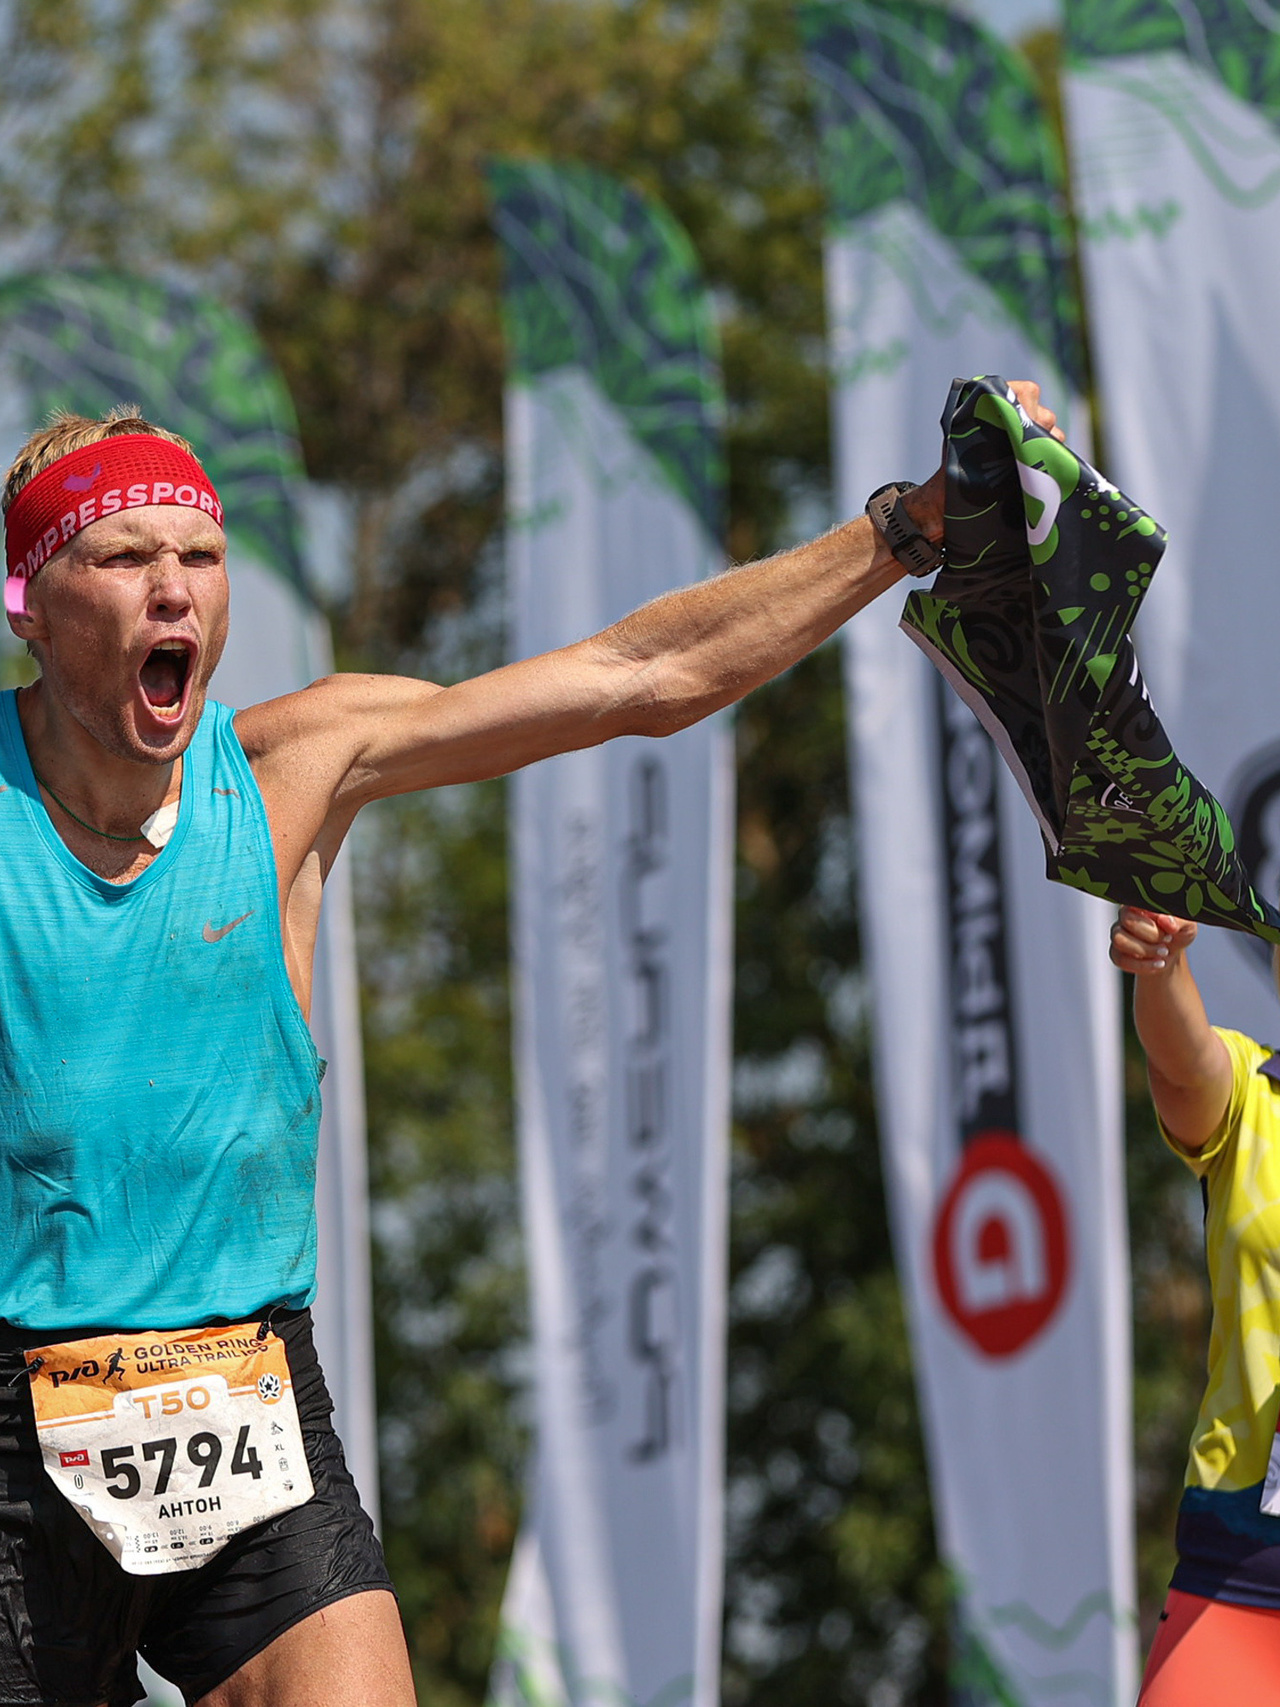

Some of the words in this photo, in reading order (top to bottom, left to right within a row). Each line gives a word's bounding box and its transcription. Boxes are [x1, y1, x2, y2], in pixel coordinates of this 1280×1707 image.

[13, 482, 223, 578] OMPRESSPORT
[134, 1343, 211, 1359] GOLDEN
[216, 1338, 261, 1350] RING
[136, 1357, 191, 1374] ULTRA
[133, 1386, 210, 1419] T50
[274, 1444, 285, 1452] XL
[100, 1424, 263, 1499] 5794
[158, 1496, 221, 1519] АНТОН
